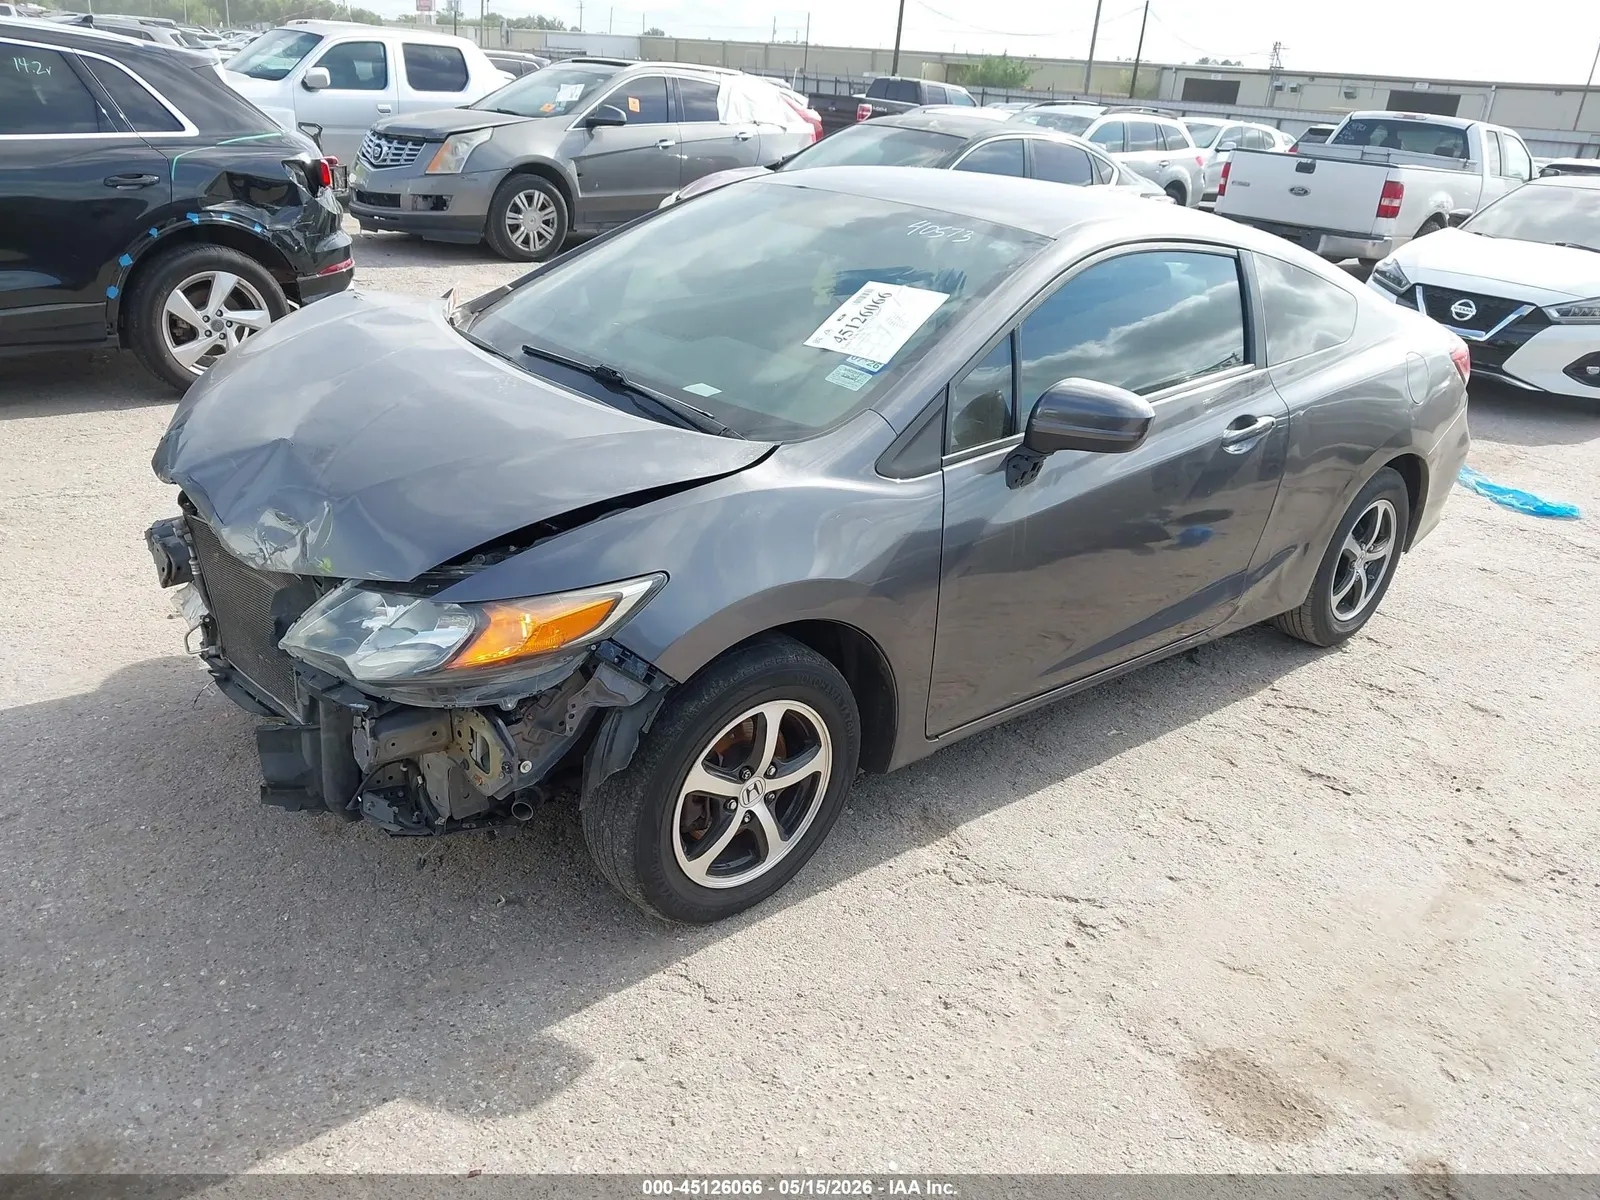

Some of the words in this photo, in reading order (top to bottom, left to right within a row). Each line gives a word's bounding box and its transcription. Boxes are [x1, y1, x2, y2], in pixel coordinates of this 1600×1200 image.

[907, 219, 974, 243] 40573
[833, 292, 893, 344] 45126066
[1452, 304, 1475, 315] NISSAN
